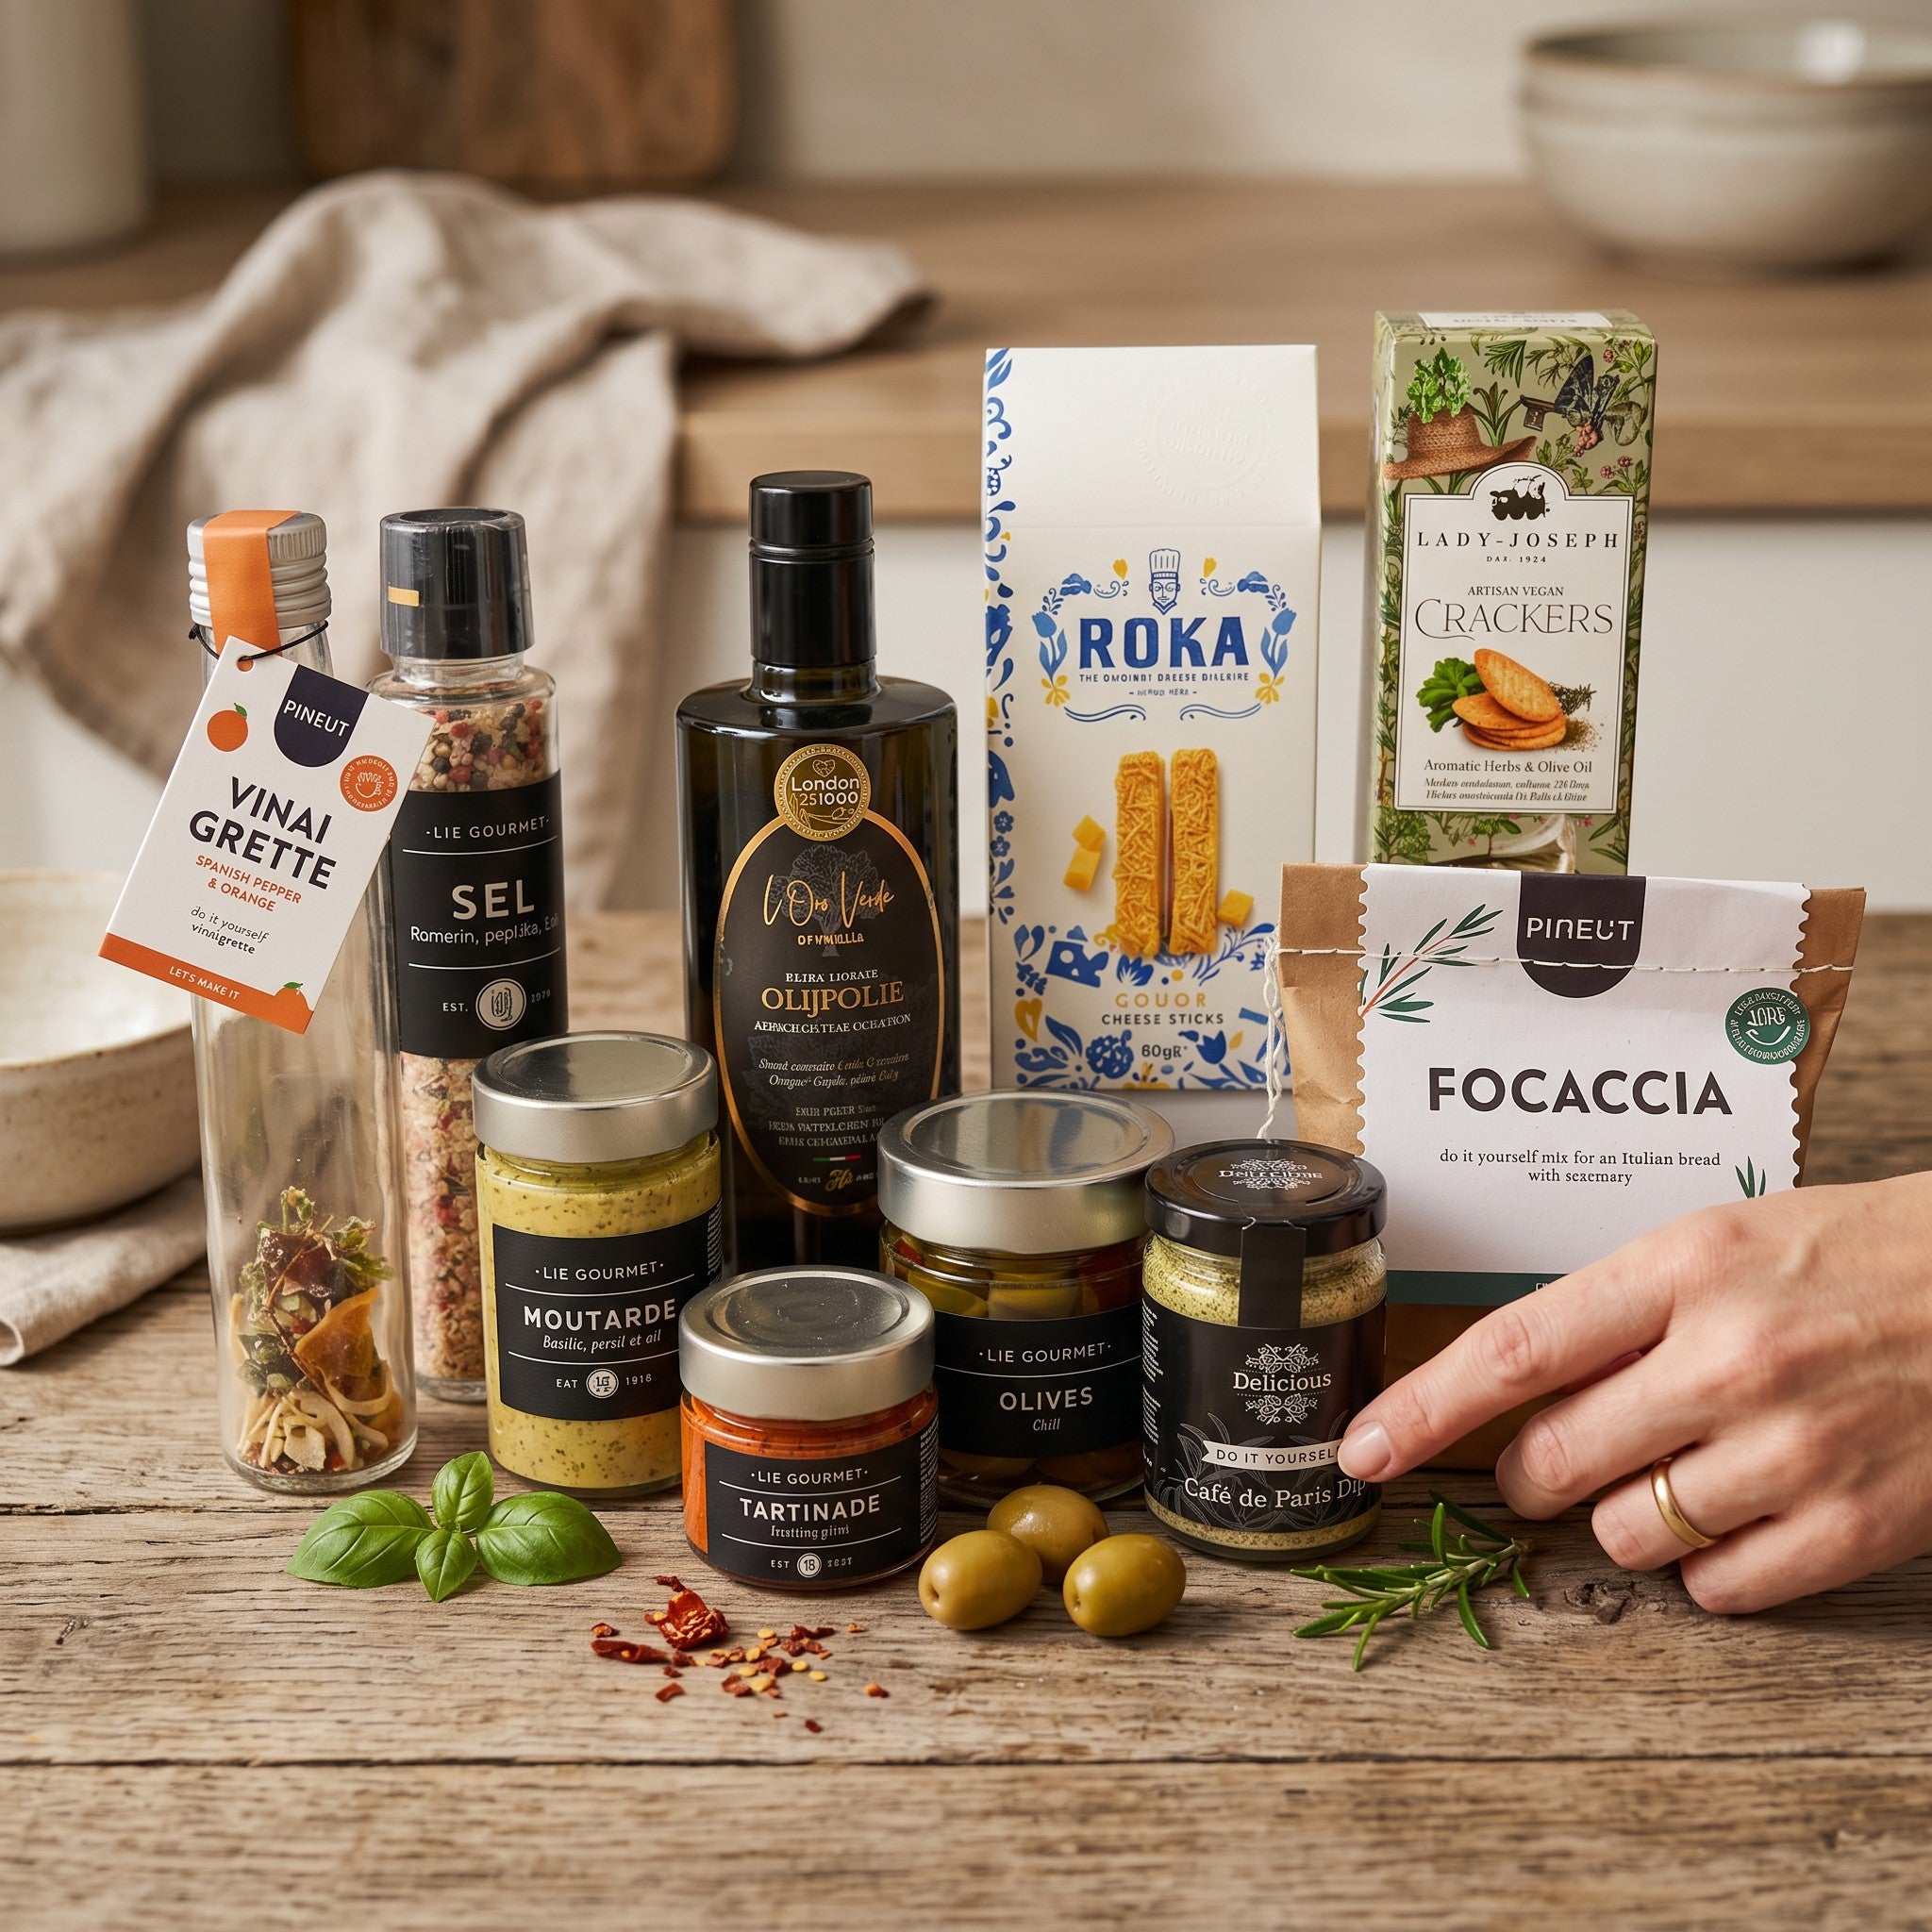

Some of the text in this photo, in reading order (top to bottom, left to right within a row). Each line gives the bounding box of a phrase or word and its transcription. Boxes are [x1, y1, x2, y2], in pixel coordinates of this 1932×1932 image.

[1417, 532, 1619, 548] LADY-JOSEPH
[1467, 586, 1564, 596] ARTISAN VEGAN
[1415, 598, 1613, 641] CRACKERS
[1079, 616, 1250, 670] ROKA
[1079, 674, 1098, 682] THE
[283, 699, 350, 737] PINEUT
[1424, 758, 1592, 773] Aromatic Herbs & Olive Oil
[791, 775, 859, 791] London
[232, 776, 333, 844] VINAI
[434, 816, 545, 839] LIE GOURMET
[190, 810, 337, 891] GRETTE
[195, 855, 302, 904] SPANISH PEPPER
[207, 877, 276, 912] & ORANGE
[451, 879, 535, 921] SEL
[191, 906, 269, 943] do it yourself
[797, 935, 813, 945] OF
[197, 978, 227, 996] MAKE
[228, 990, 241, 1000] IT
[761, 981, 905, 1019] OLIJPOLIE
[442, 1002, 469, 1012] EST.
[1101, 1013, 1224, 1025] CHEESE STICKS
[1428, 1067, 1733, 1115] FOCACCIA
[1440, 1148, 1458, 1162] do
[1462, 1148, 1474, 1162] it
[1478, 1149, 1540, 1166] yourself
[1541, 1151, 1568, 1164] mix
[1574, 1150, 1595, 1164] for
[1599, 1154, 1617, 1165] an
[1678, 1152, 1721, 1166] bread
[1528, 1168, 1560, 1182] with
[542, 1260, 658, 1281] LIE GOURMET
[524, 1298, 676, 1331] MOUTARDE
[542, 1329, 661, 1353] Basilic, persil et ail
[988, 1341, 1106, 1363] LIE GOURMET
[556, 1378, 578, 1390] EAT
[1232, 1370, 1332, 1393] Delicious
[999, 1386, 1093, 1411] OLIVES
[1032, 1417, 1061, 1431] Chill
[1216, 1446, 1339, 1465] DO IT YOURSEL
[758, 1468, 863, 1485] LIE GOURMET
[1184, 1477, 1366, 1508] Café de Paris Dip
[739, 1493, 880, 1522] TARTINADE
[771, 1559, 790, 1569] EST
